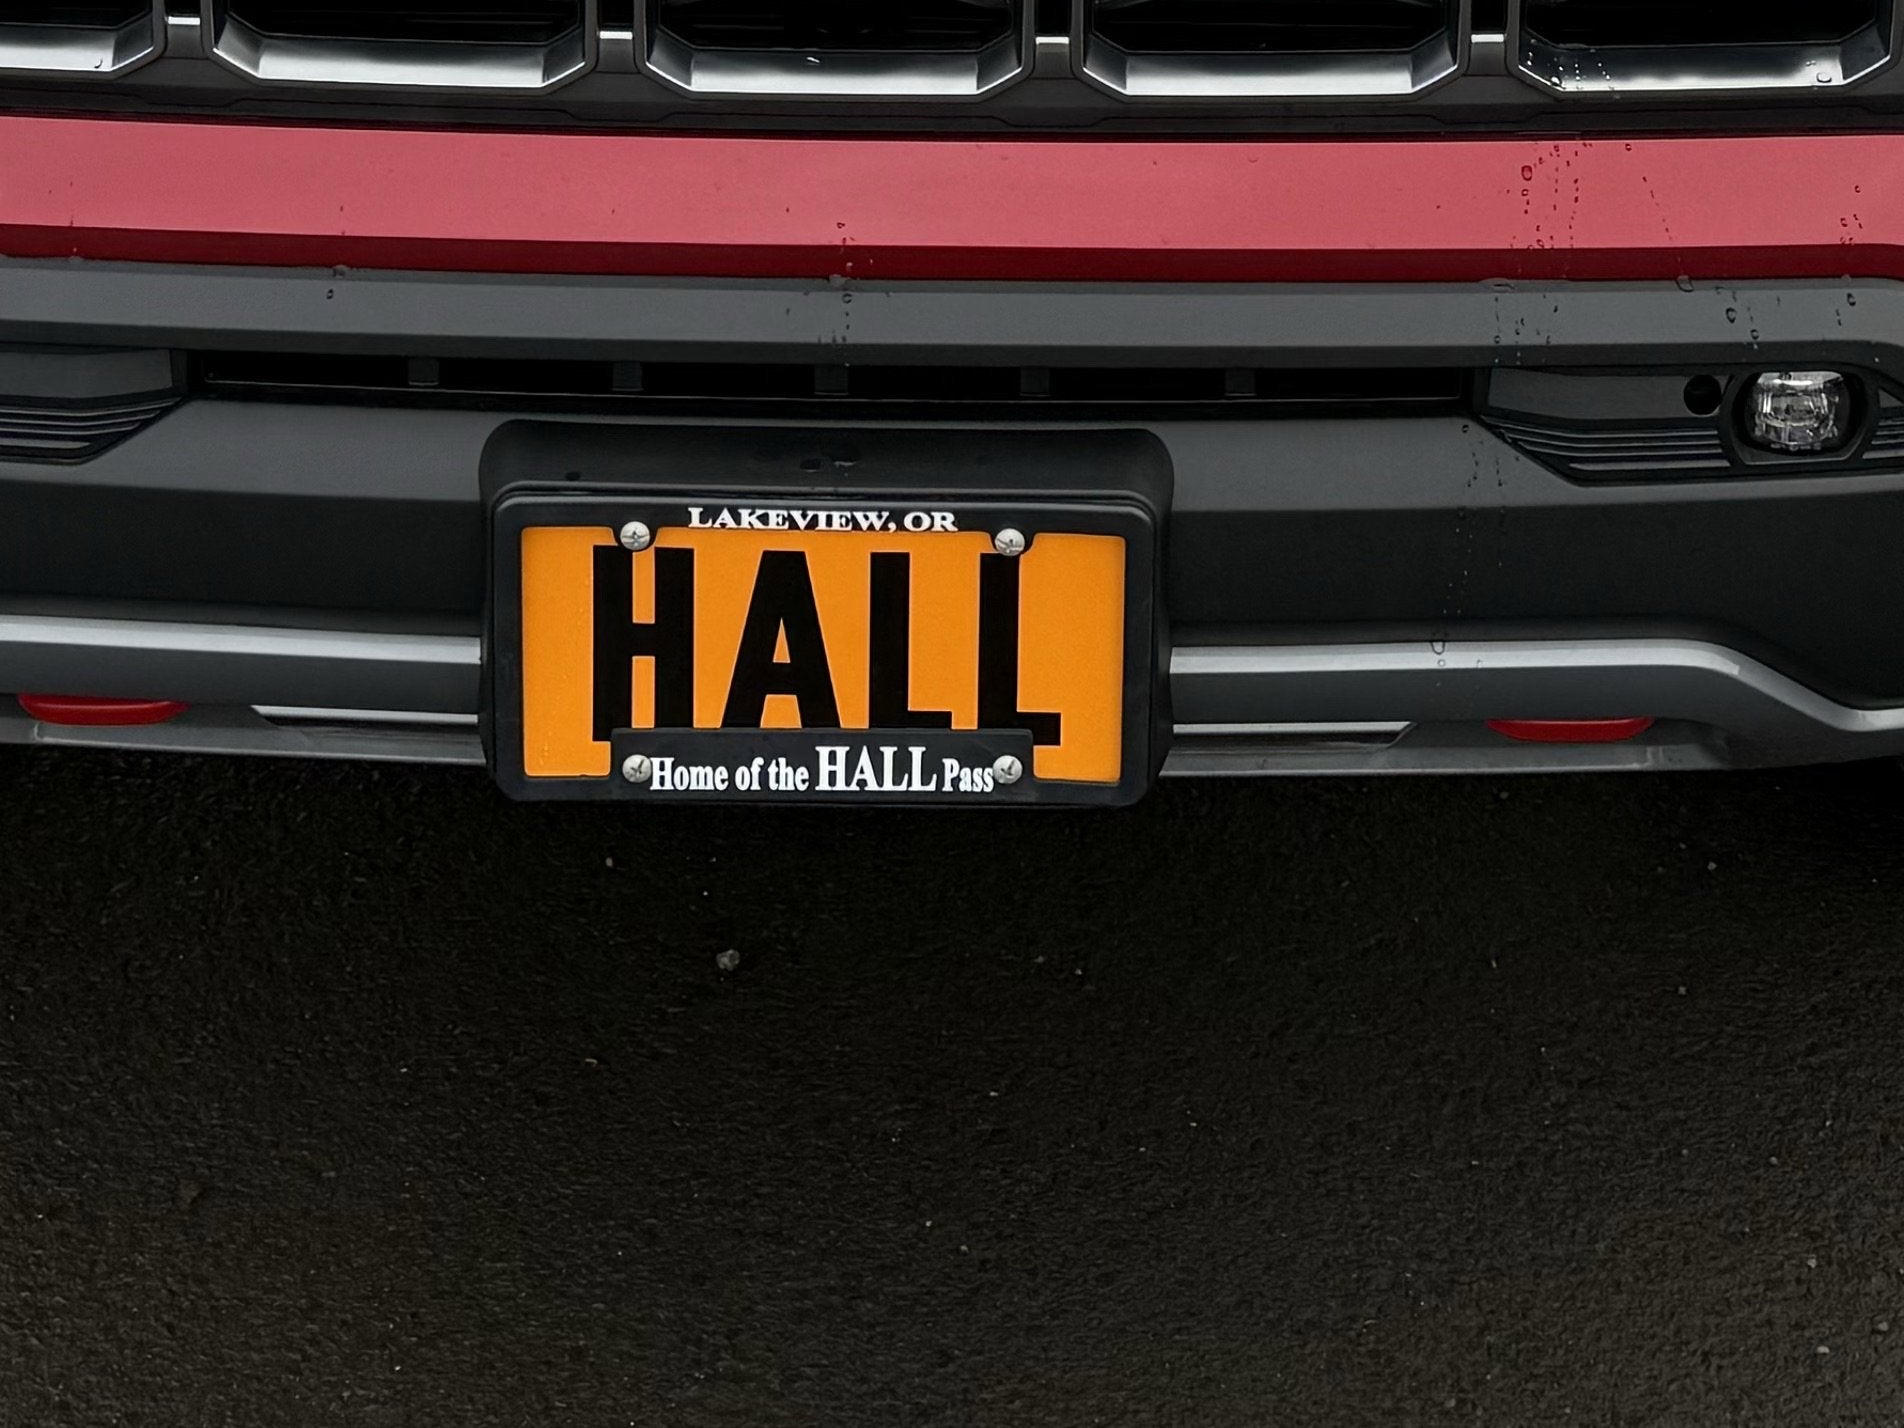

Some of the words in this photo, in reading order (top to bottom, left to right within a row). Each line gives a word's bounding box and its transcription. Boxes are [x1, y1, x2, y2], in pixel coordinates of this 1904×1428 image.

[687, 506, 898, 534] LAKEVIEW,
[903, 510, 958, 533] OR
[592, 544, 1061, 747] HALL
[649, 756, 729, 792] Home
[734, 756, 764, 792] of
[766, 758, 809, 792] the
[814, 745, 938, 793] HALL
[941, 758, 995, 794] Pass
